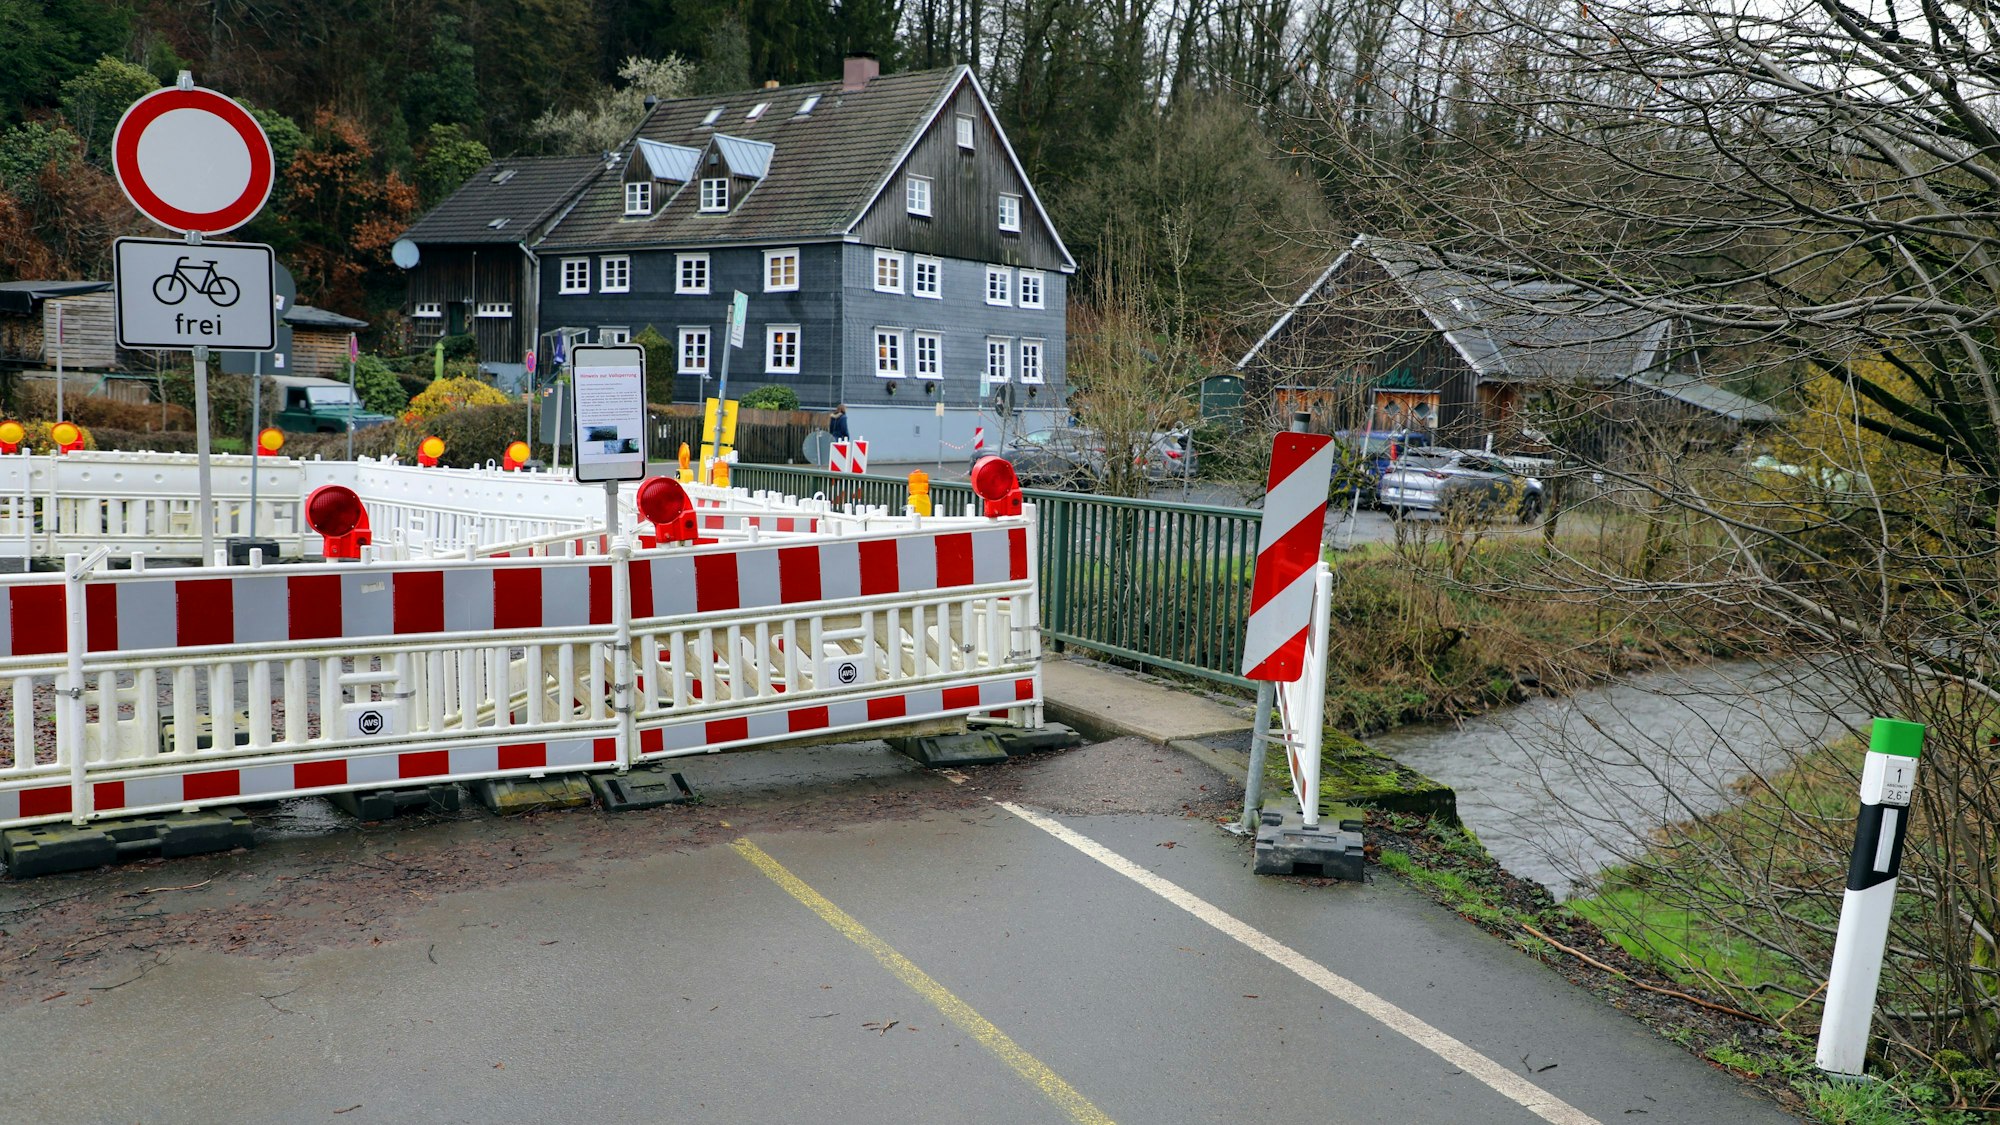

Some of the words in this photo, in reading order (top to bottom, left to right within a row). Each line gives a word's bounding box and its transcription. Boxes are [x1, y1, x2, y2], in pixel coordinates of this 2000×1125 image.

[175, 313, 222, 335] frei
[842, 669, 854, 677] AVS
[363, 719, 379, 727] AVS
[1897, 768, 1902, 783] 1
